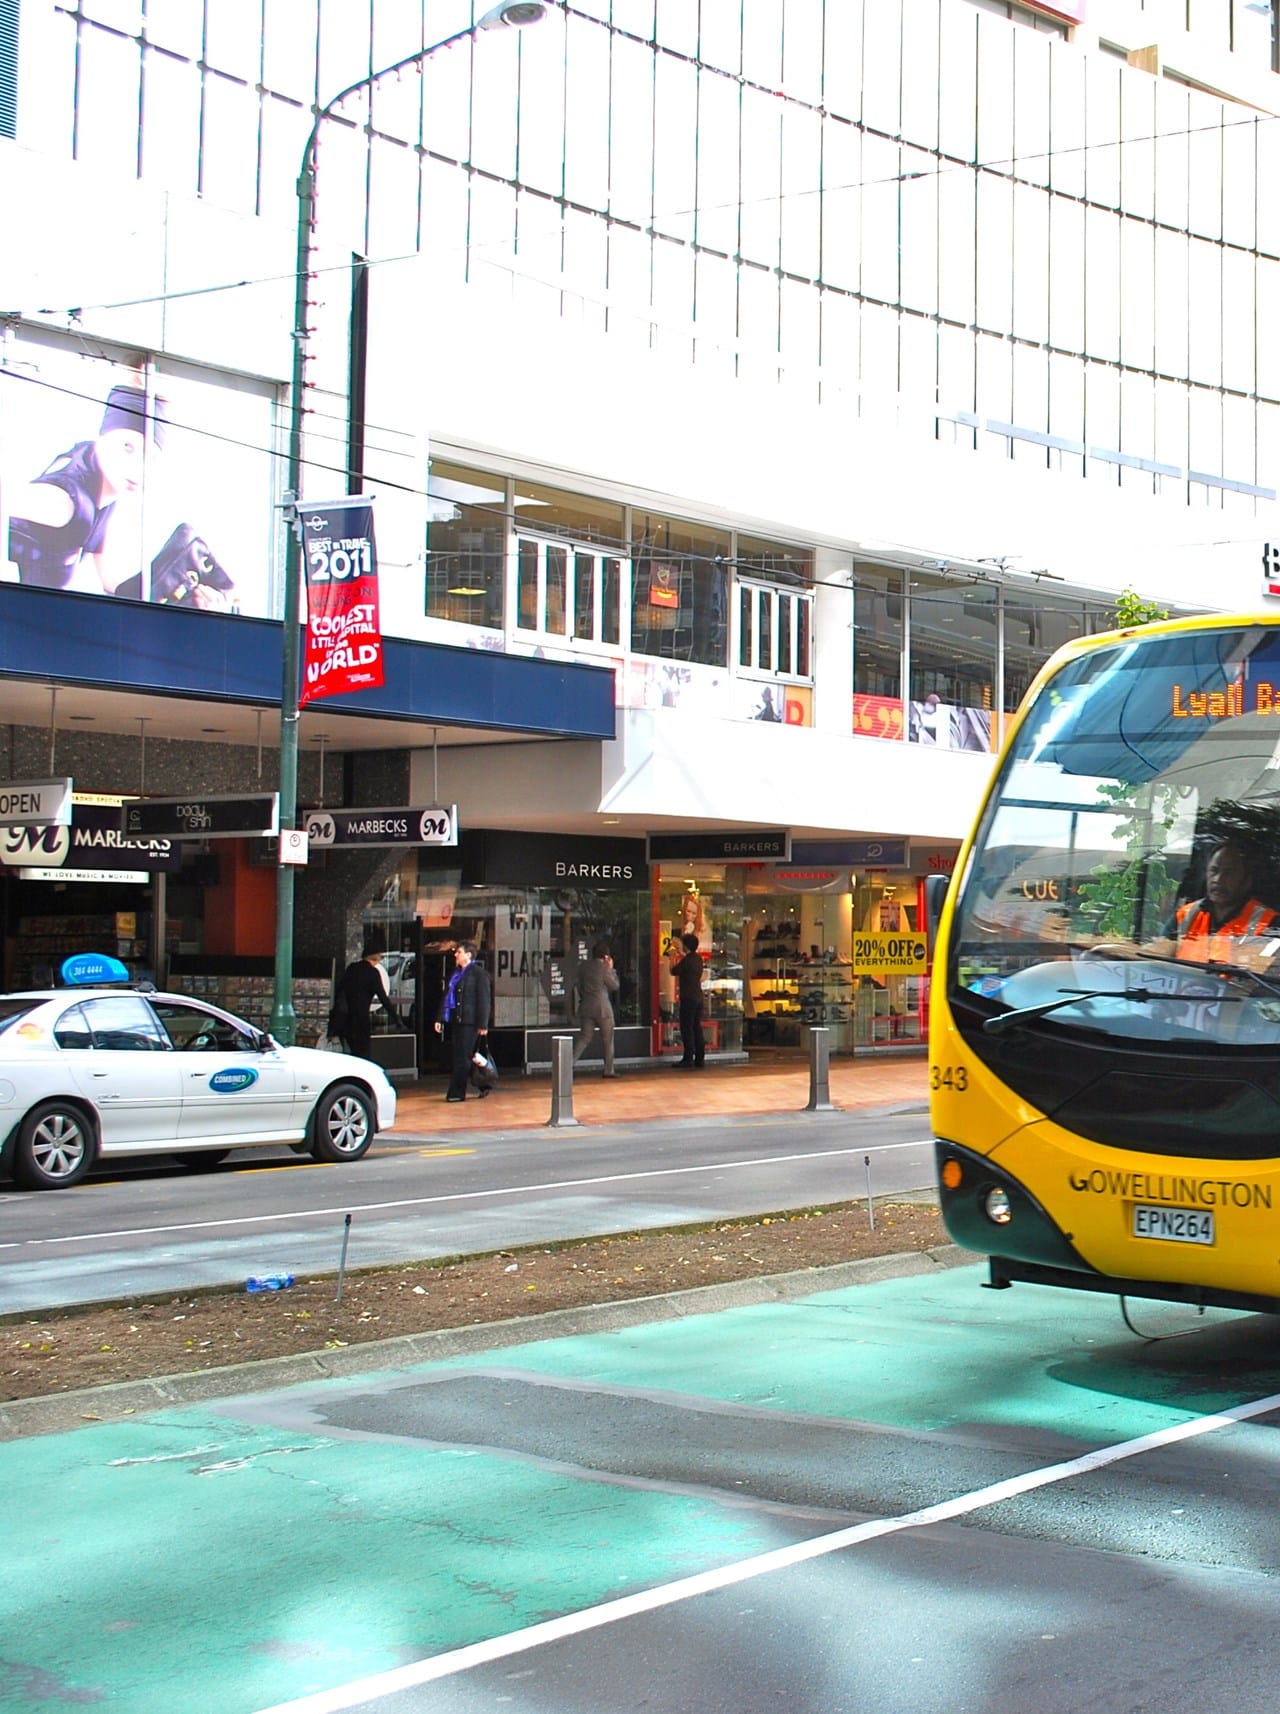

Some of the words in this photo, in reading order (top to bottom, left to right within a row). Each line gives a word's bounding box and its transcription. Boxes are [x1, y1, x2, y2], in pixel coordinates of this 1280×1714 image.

[310, 547, 371, 580] 2011
[1171, 683, 1243, 717] Lyall
[0, 792, 41, 815] OPEN
[347, 818, 408, 836] MARBECKS
[724, 841, 780, 852] BARKERS
[555, 861, 633, 879] BARKERS
[855, 940, 886, 958] 20%
[887, 939, 915, 958] OFF
[855, 957, 913, 967] EVERYTHING
[930, 1065, 969, 1092] 343
[1135, 1208, 1213, 1240] EPN264
